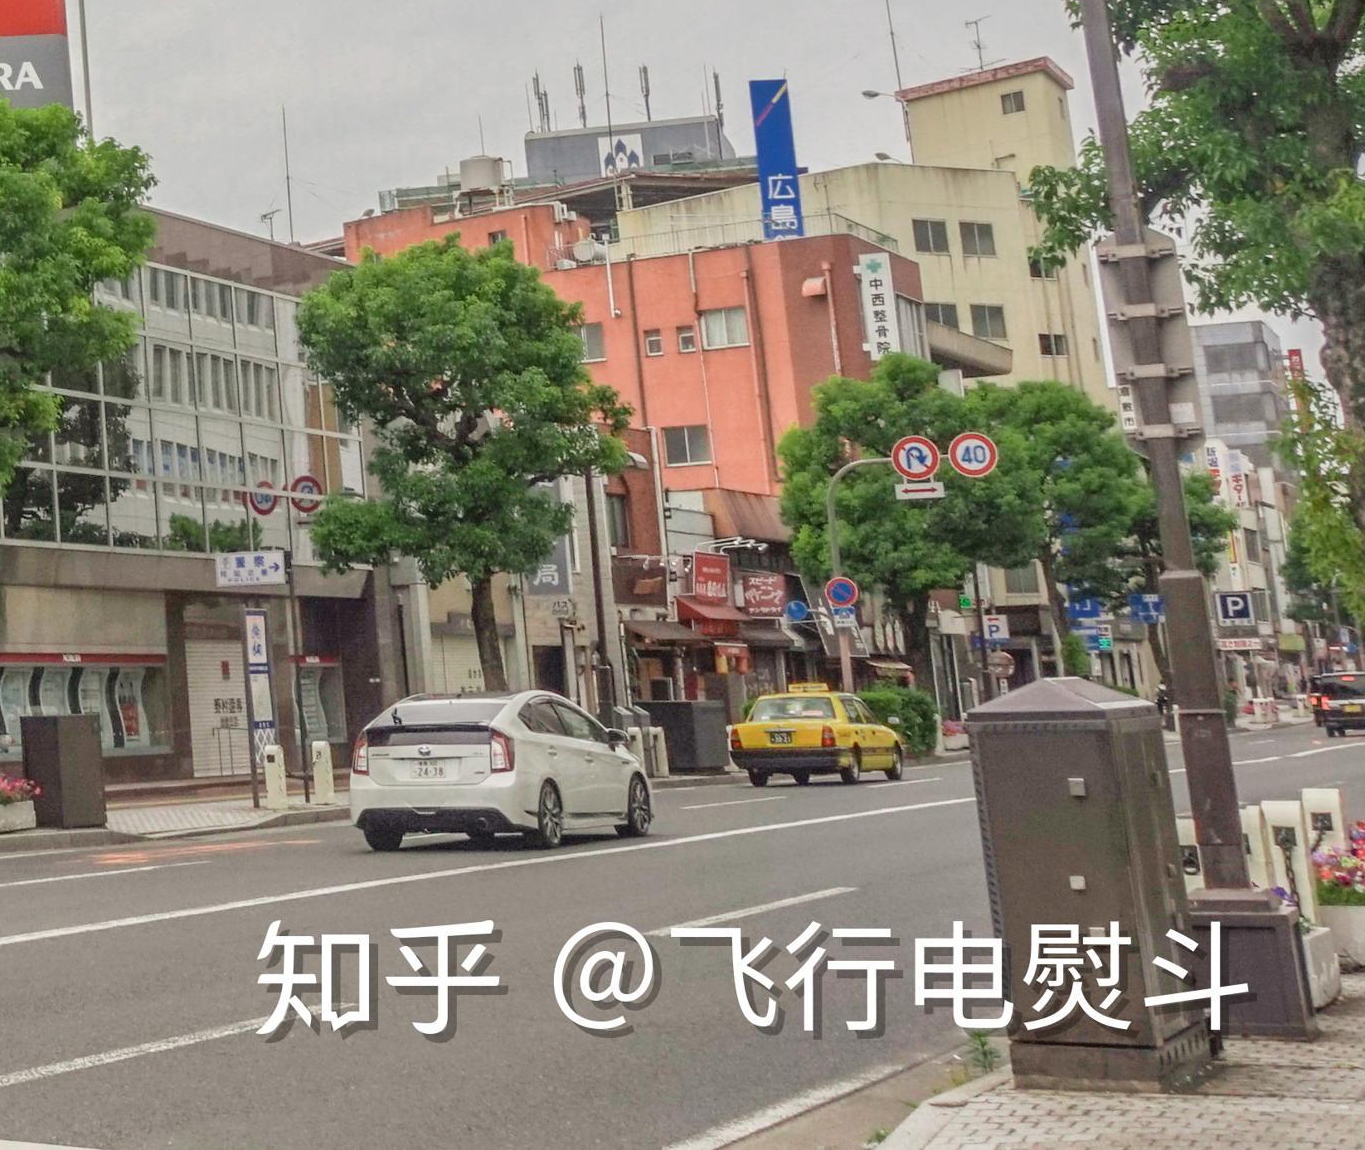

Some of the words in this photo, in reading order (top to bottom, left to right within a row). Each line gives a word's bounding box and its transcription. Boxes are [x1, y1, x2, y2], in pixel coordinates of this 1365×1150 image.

[869, 278, 891, 354] 中西整骨院
[961, 445, 986, 464] 40
[533, 564, 559, 586] 局
[1226, 596, 1245, 617] P
[988, 624, 1000, 638] P
